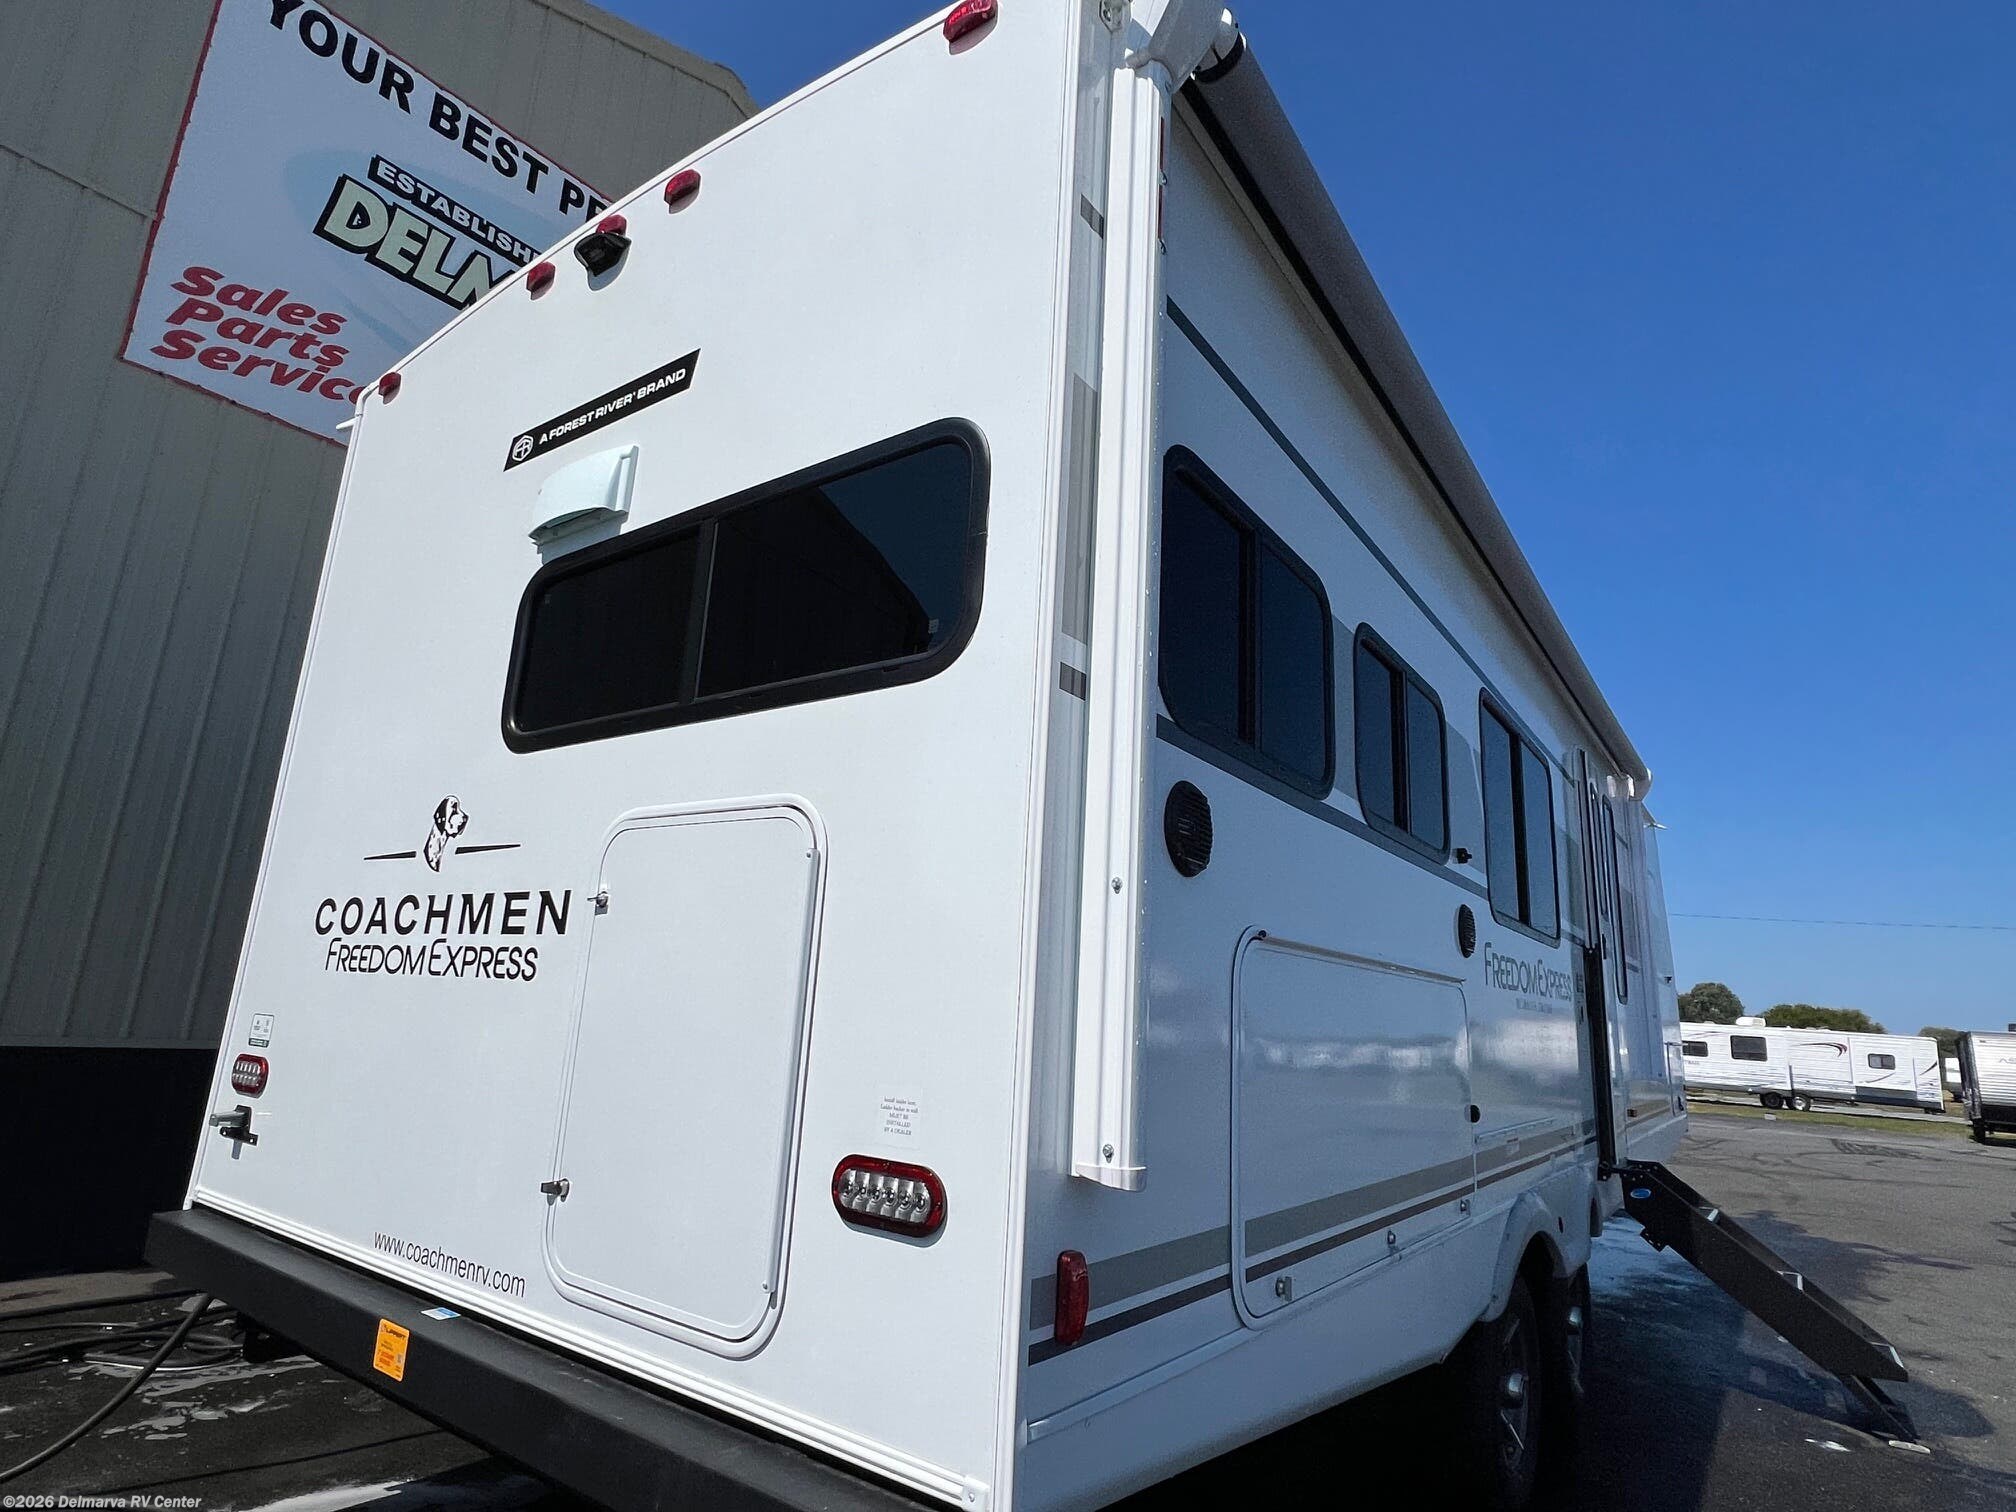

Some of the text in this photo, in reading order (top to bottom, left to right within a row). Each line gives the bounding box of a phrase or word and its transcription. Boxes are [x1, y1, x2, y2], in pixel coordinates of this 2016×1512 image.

[270, 0, 414, 114] YOUR
[428, 90, 550, 194] BEST
[165, 297, 349, 367] Parts
[171, 267, 347, 335] Sales
[539, 433, 548, 445] A
[548, 410, 595, 440] FOREST
[636, 368, 686, 400] BRAND
[315, 890, 572, 935] COACHMEN
[374, 1231, 526, 1298] www.coachmenrv.com
